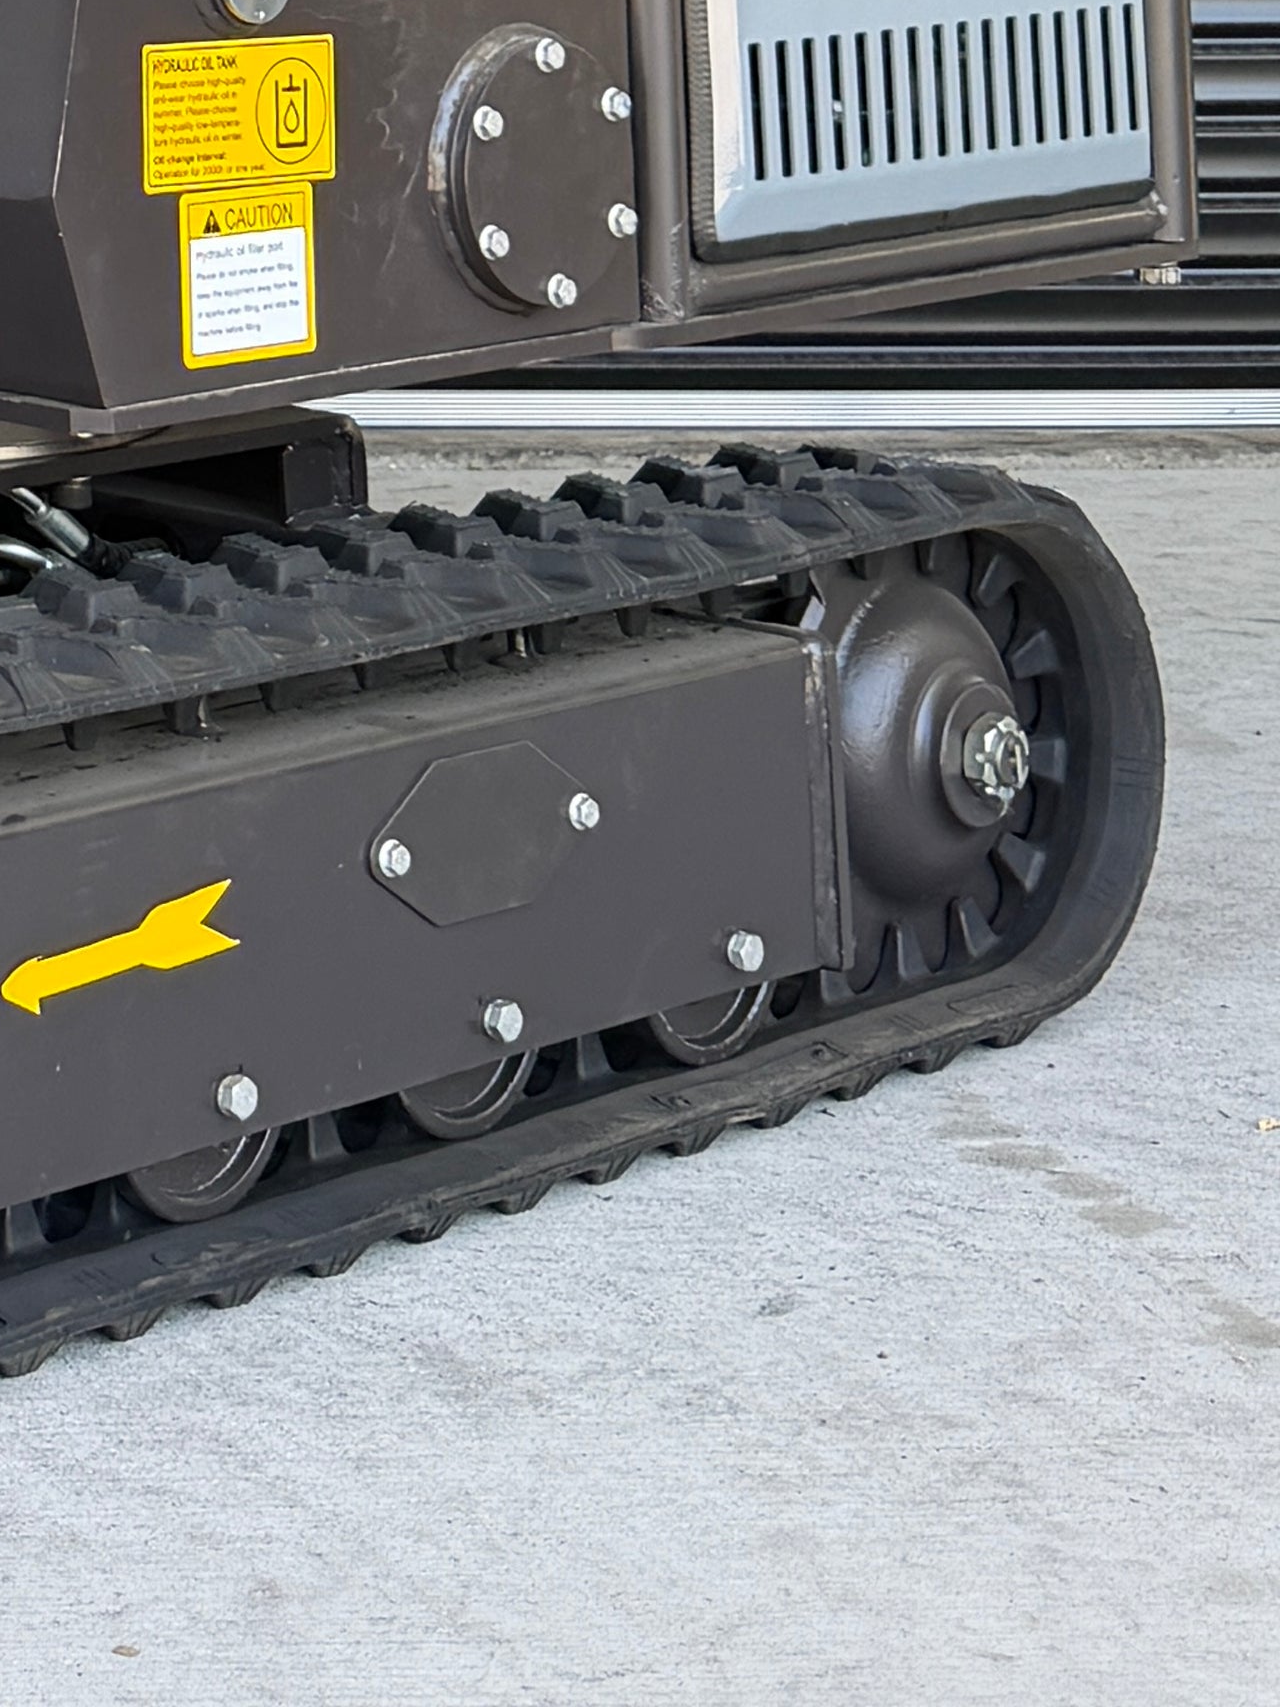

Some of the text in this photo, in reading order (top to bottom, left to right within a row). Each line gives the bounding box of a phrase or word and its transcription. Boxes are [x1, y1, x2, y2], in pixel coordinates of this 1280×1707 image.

[153, 55, 238, 74] HYDRAULIC OIL TANK
[225, 203, 293, 230] CAUTION
